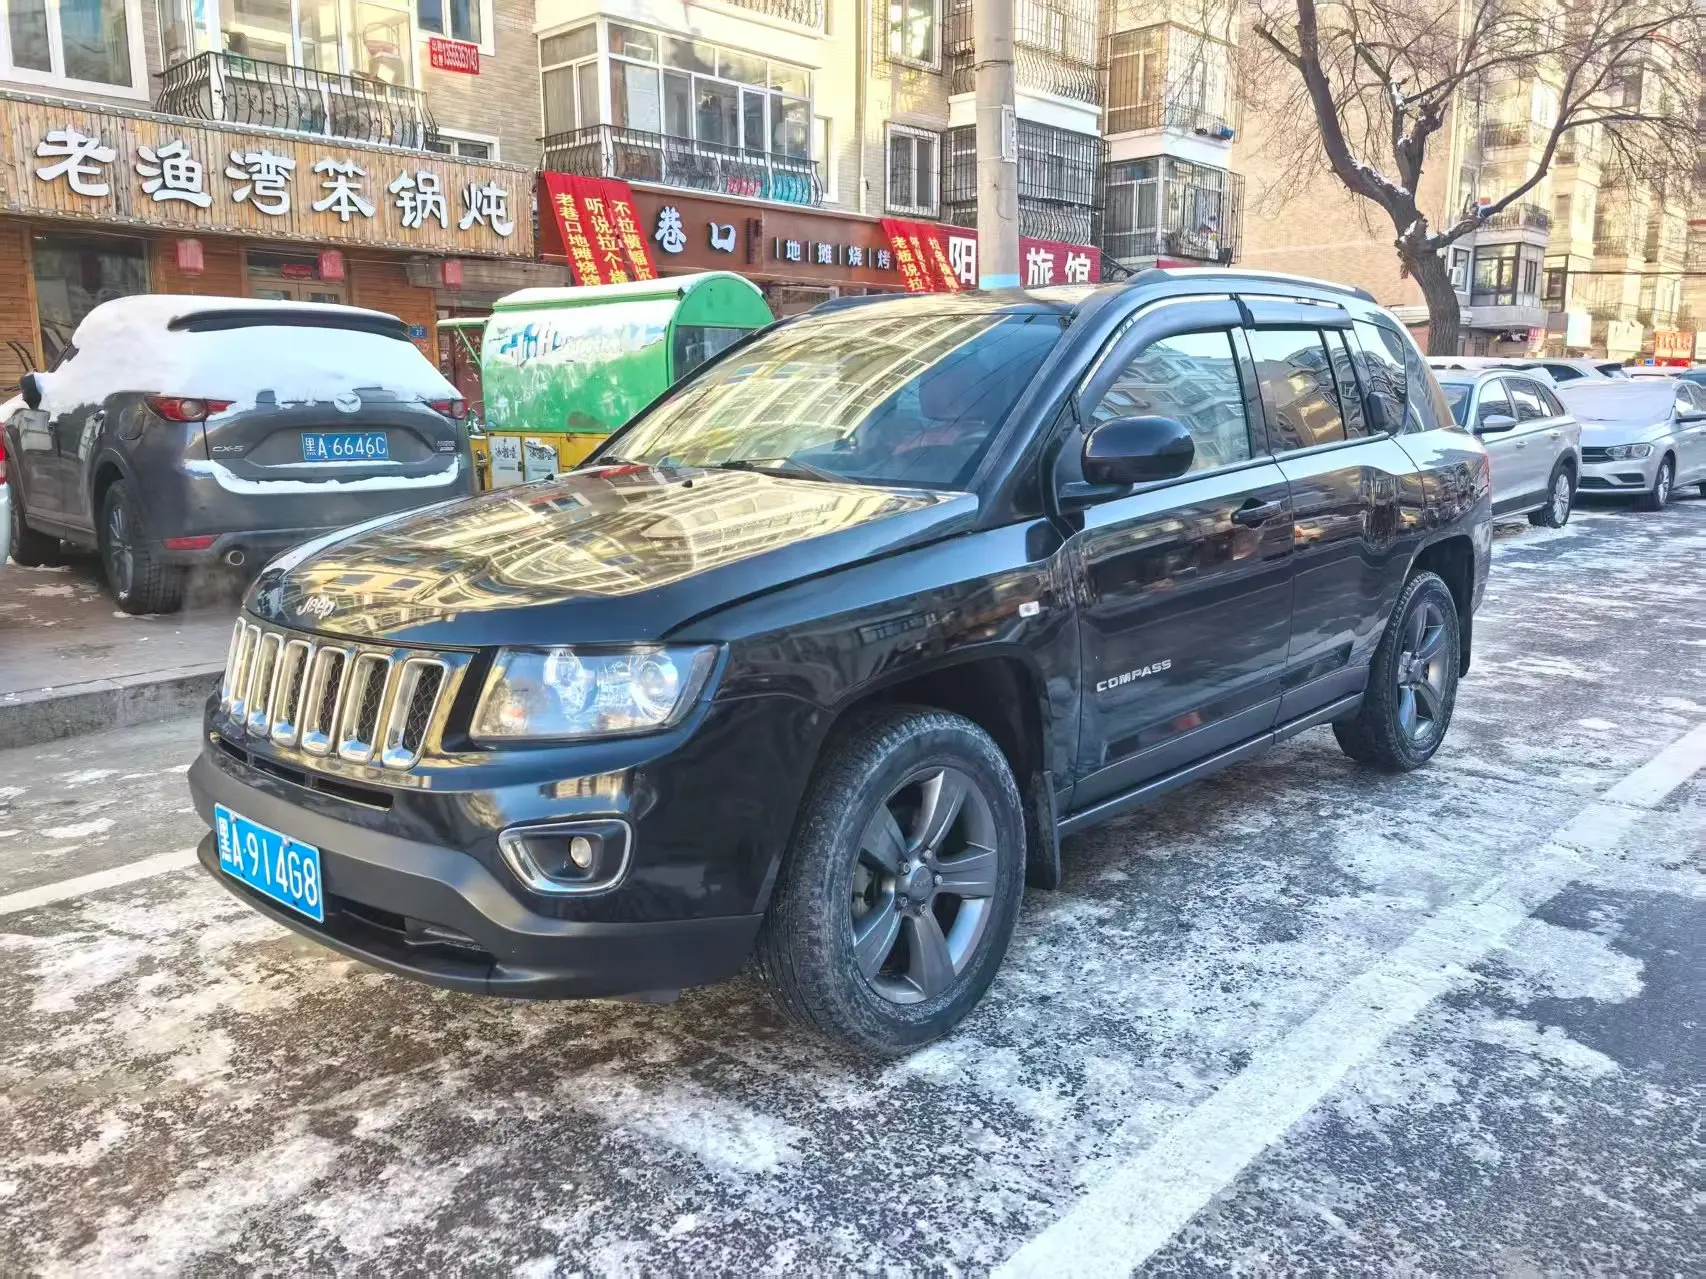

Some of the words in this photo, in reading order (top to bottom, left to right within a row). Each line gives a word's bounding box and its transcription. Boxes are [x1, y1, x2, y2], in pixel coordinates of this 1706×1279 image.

[36, 124, 514, 237] 老渔湾笨锅炖
[655, 206, 737, 253] 巷口
[296, 595, 337, 620] Jeep
[1096, 659, 1172, 693] COMPASS
